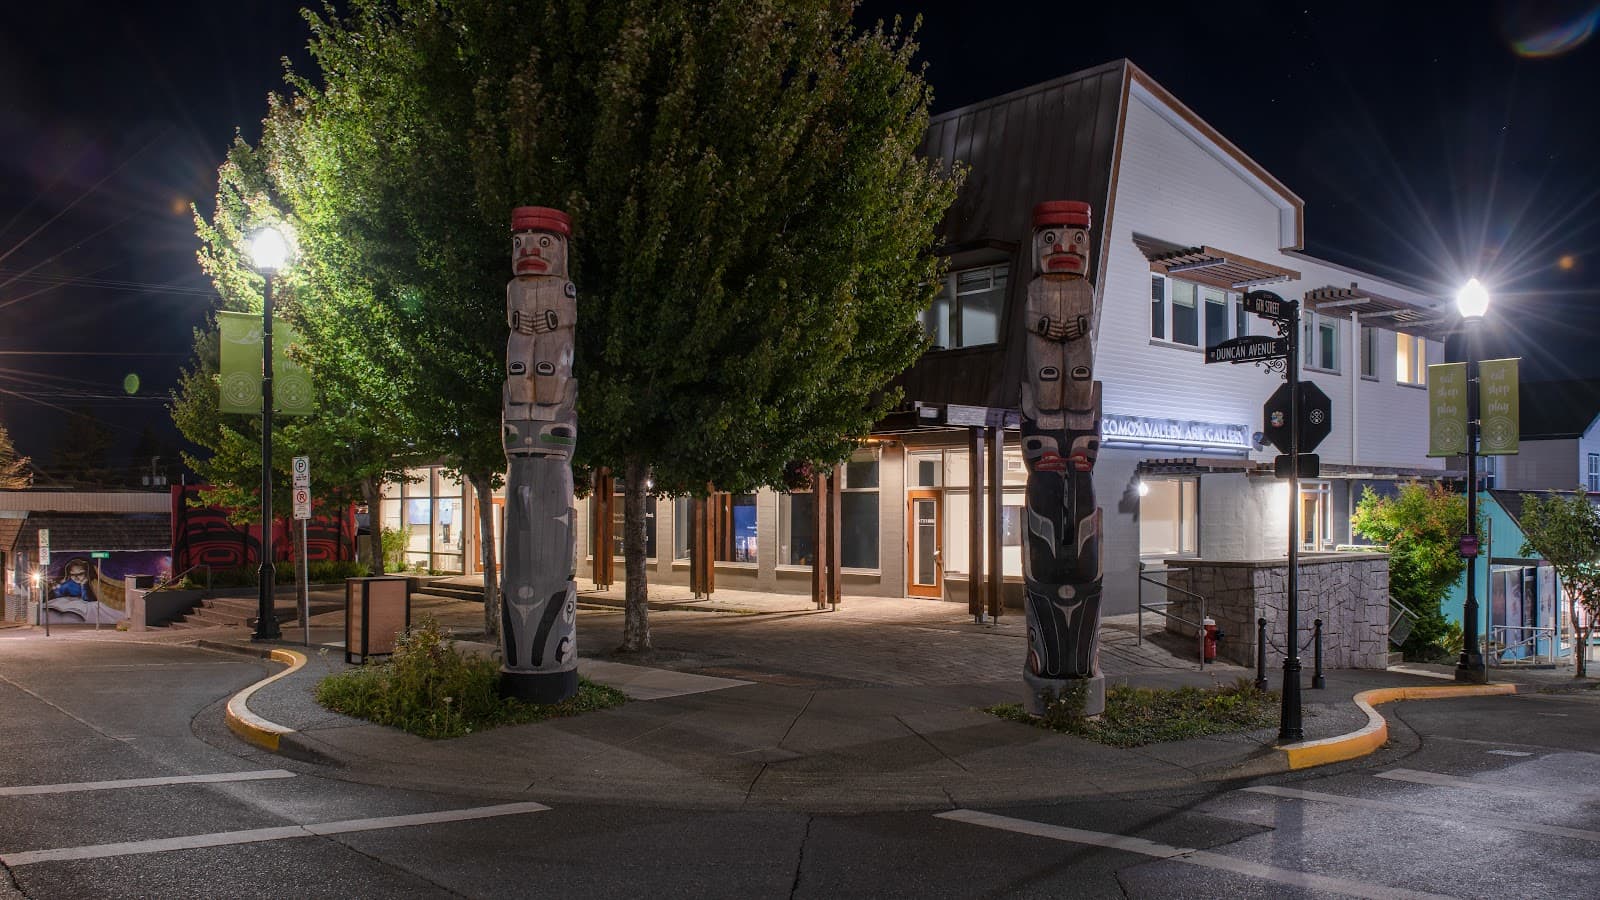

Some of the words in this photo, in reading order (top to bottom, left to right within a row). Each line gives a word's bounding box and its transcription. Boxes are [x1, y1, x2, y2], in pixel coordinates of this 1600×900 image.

[1255, 298, 1265, 313] 6TH
[1265, 299, 1280, 316] STREET
[1216, 344, 1246, 360] DUNCAN
[1248, 341, 1277, 357] AVENUE
[1437, 402, 1457, 416] play
[1488, 400, 1509, 415] play
[1102, 418, 1143, 436] COMOX
[1144, 422, 1182, 439] VALLEY
[1205, 428, 1244, 443] GALLERY
